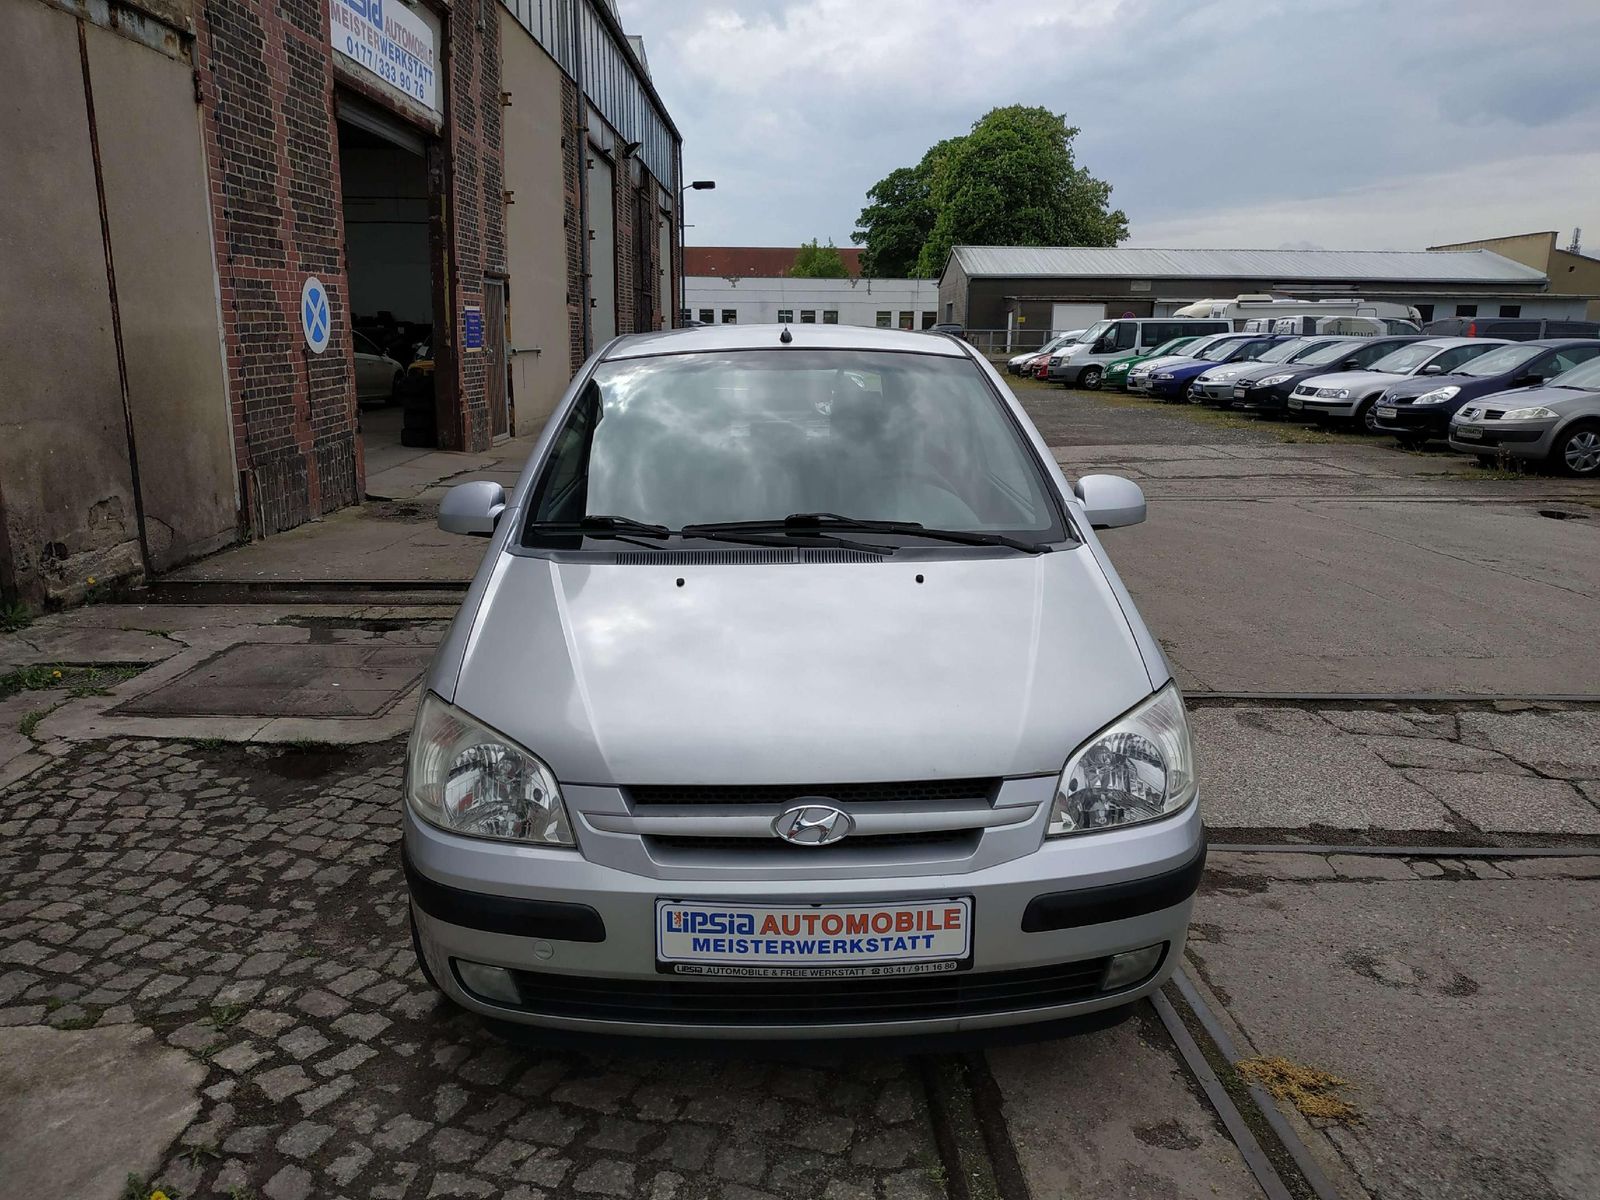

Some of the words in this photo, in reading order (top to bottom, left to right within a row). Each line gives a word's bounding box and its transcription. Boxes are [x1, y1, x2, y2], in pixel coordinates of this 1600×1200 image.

[331, 1, 433, 87] MEISTERWERKSTATT
[399, 71, 411, 91] 90
[414, 81, 424, 99] 76
[760, 908, 962, 936] AUTOMOBILE
[693, 934, 935, 955] MEISTERWERKSTATT
[706, 968, 769, 976] AUTOMOBILE
[771, 968, 778, 976] &
[780, 969, 807, 977] FREIE
[809, 968, 866, 977] WERKSTATT
